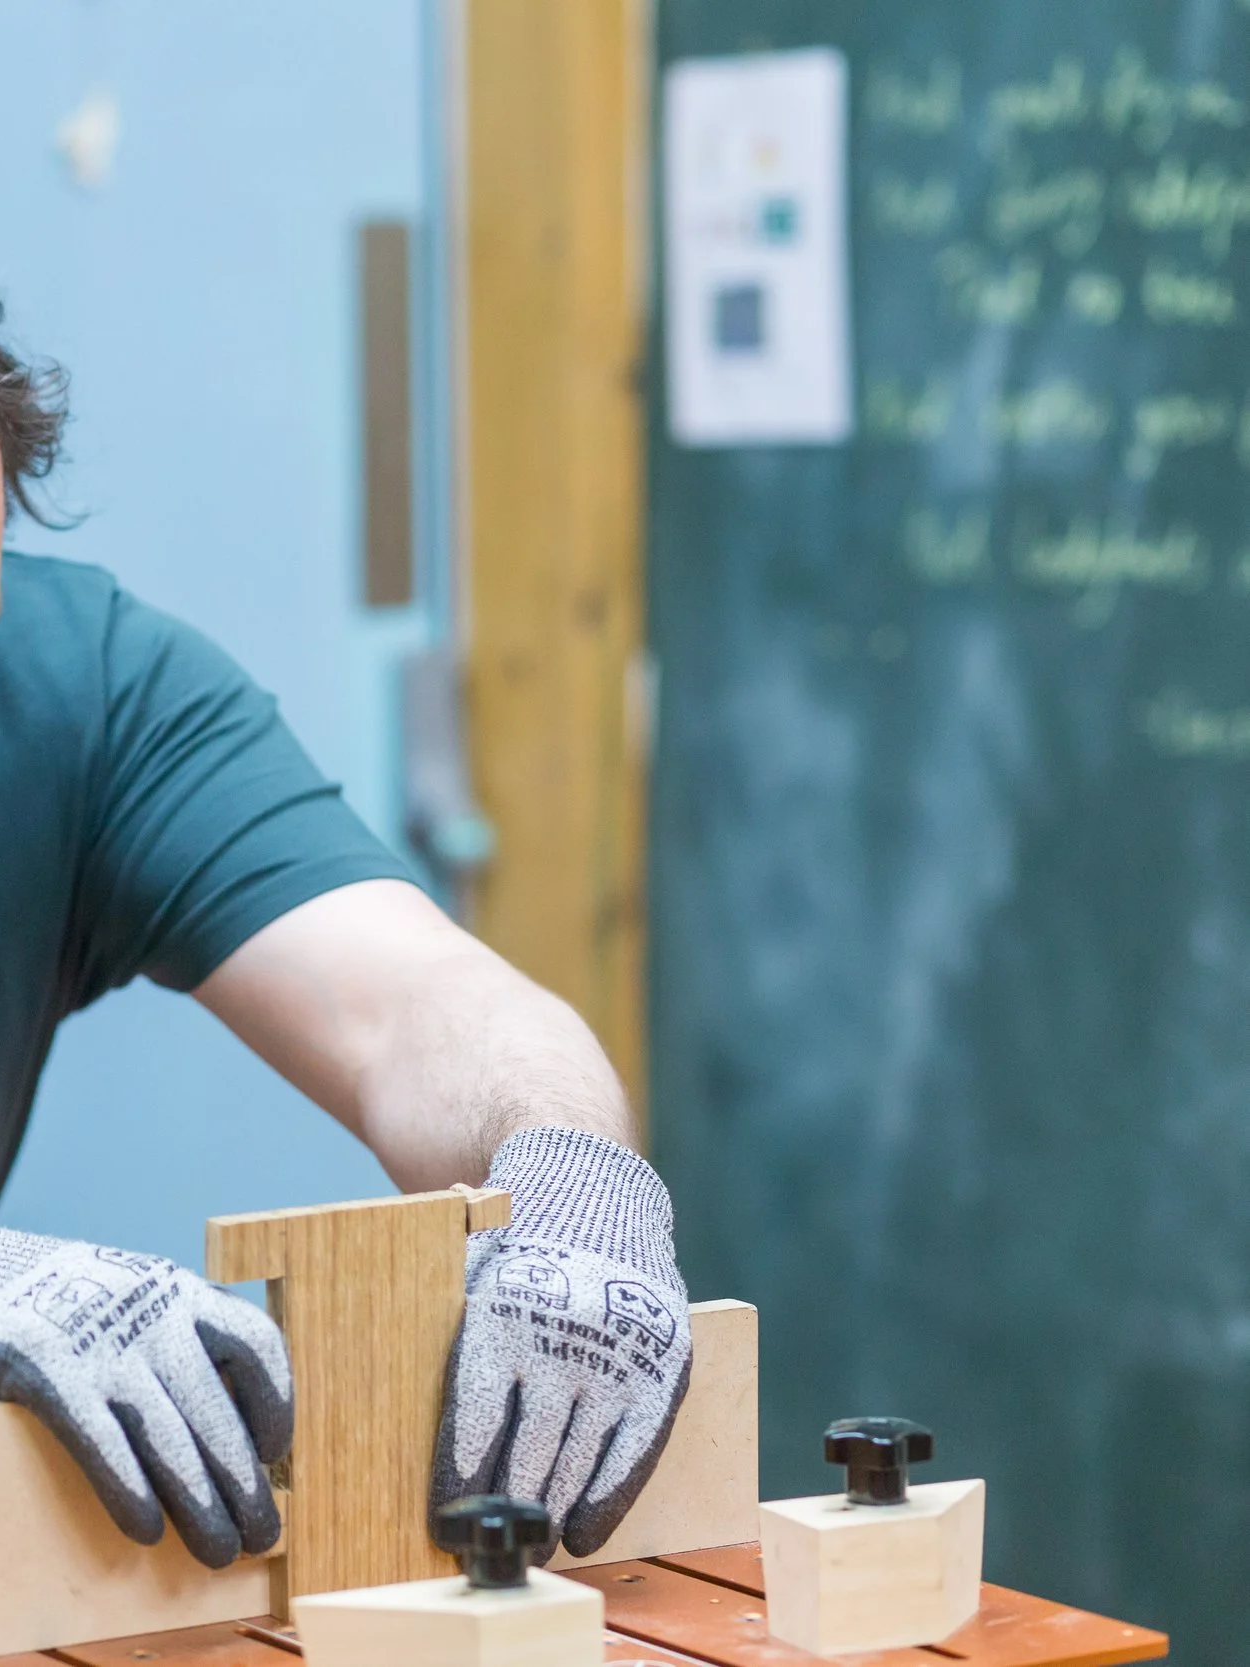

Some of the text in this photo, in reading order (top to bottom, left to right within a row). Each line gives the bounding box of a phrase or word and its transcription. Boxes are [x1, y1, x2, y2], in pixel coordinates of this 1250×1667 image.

[530, 1310, 618, 1351] MEDIUM
[603, 1312, 668, 1360] ANSI
[533, 1331, 629, 1384] #455PU
